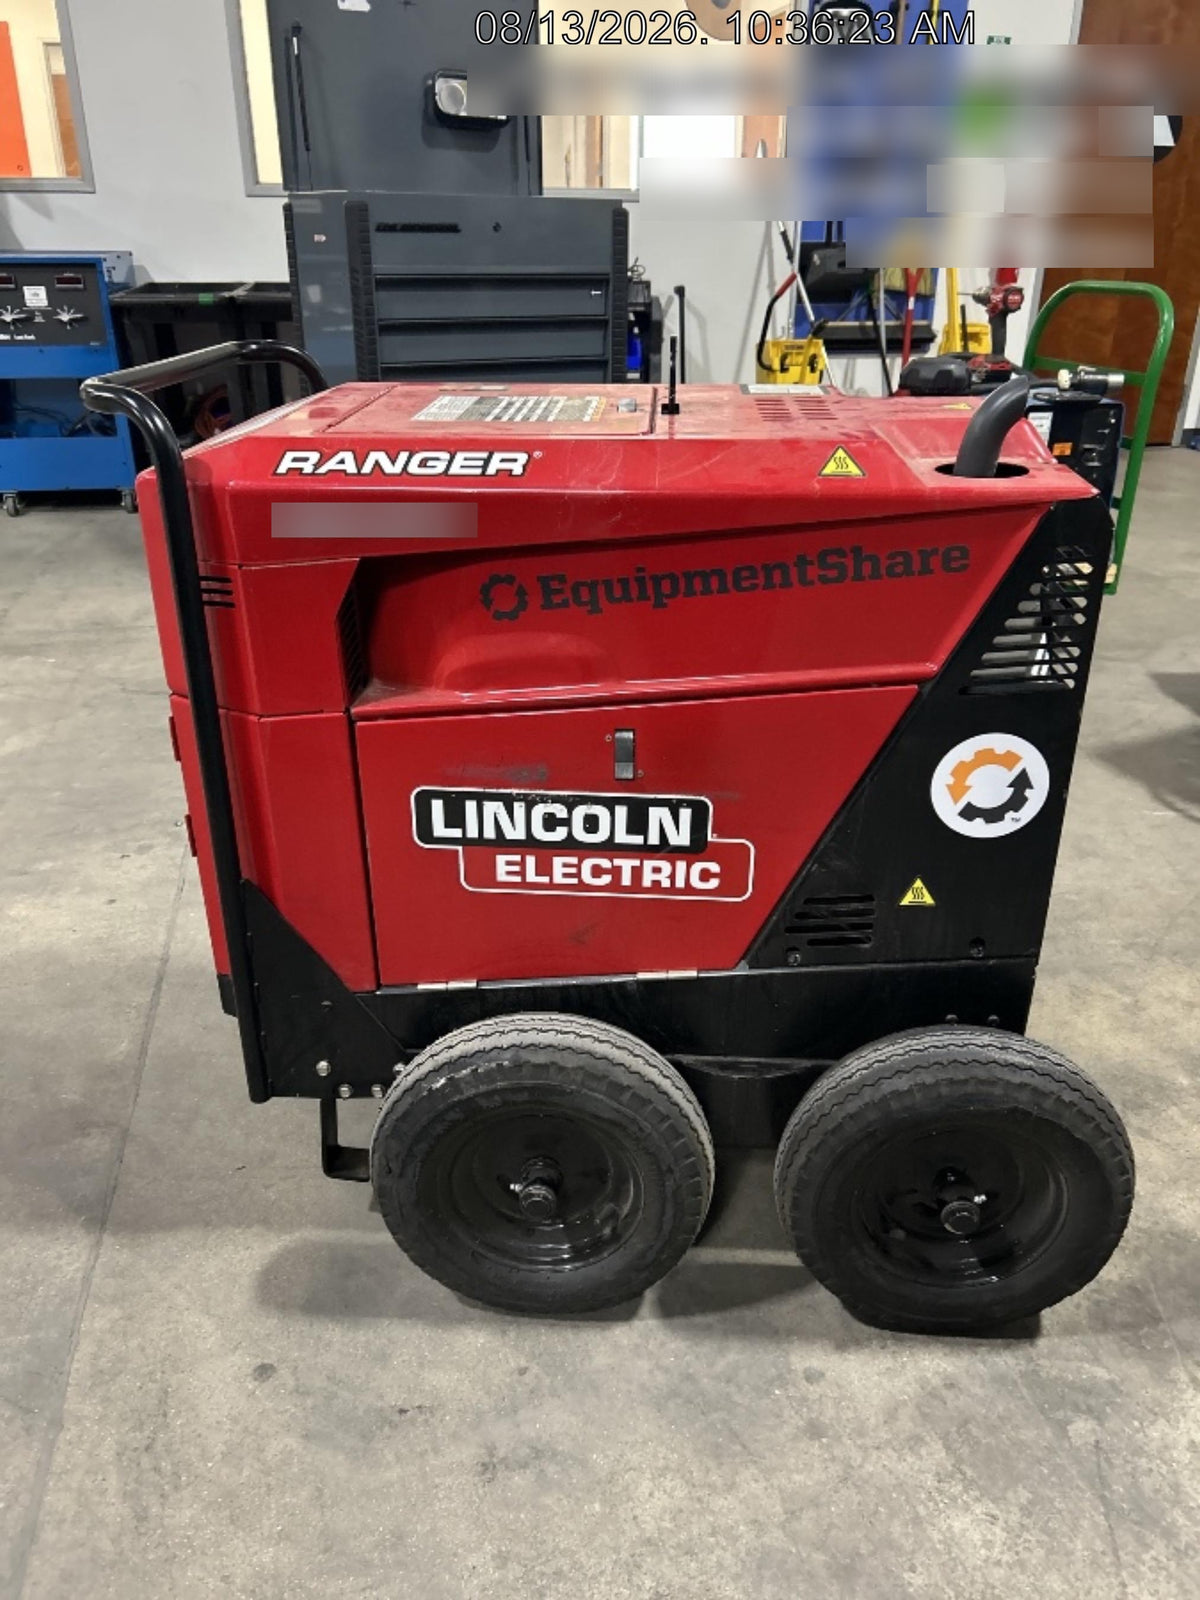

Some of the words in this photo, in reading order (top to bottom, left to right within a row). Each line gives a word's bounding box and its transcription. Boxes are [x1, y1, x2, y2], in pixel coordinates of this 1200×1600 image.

[537, 543, 971, 614] EquipmentShare
[431, 799, 691, 847] LINCOLN
[495, 854, 720, 890] ELECTRIC
